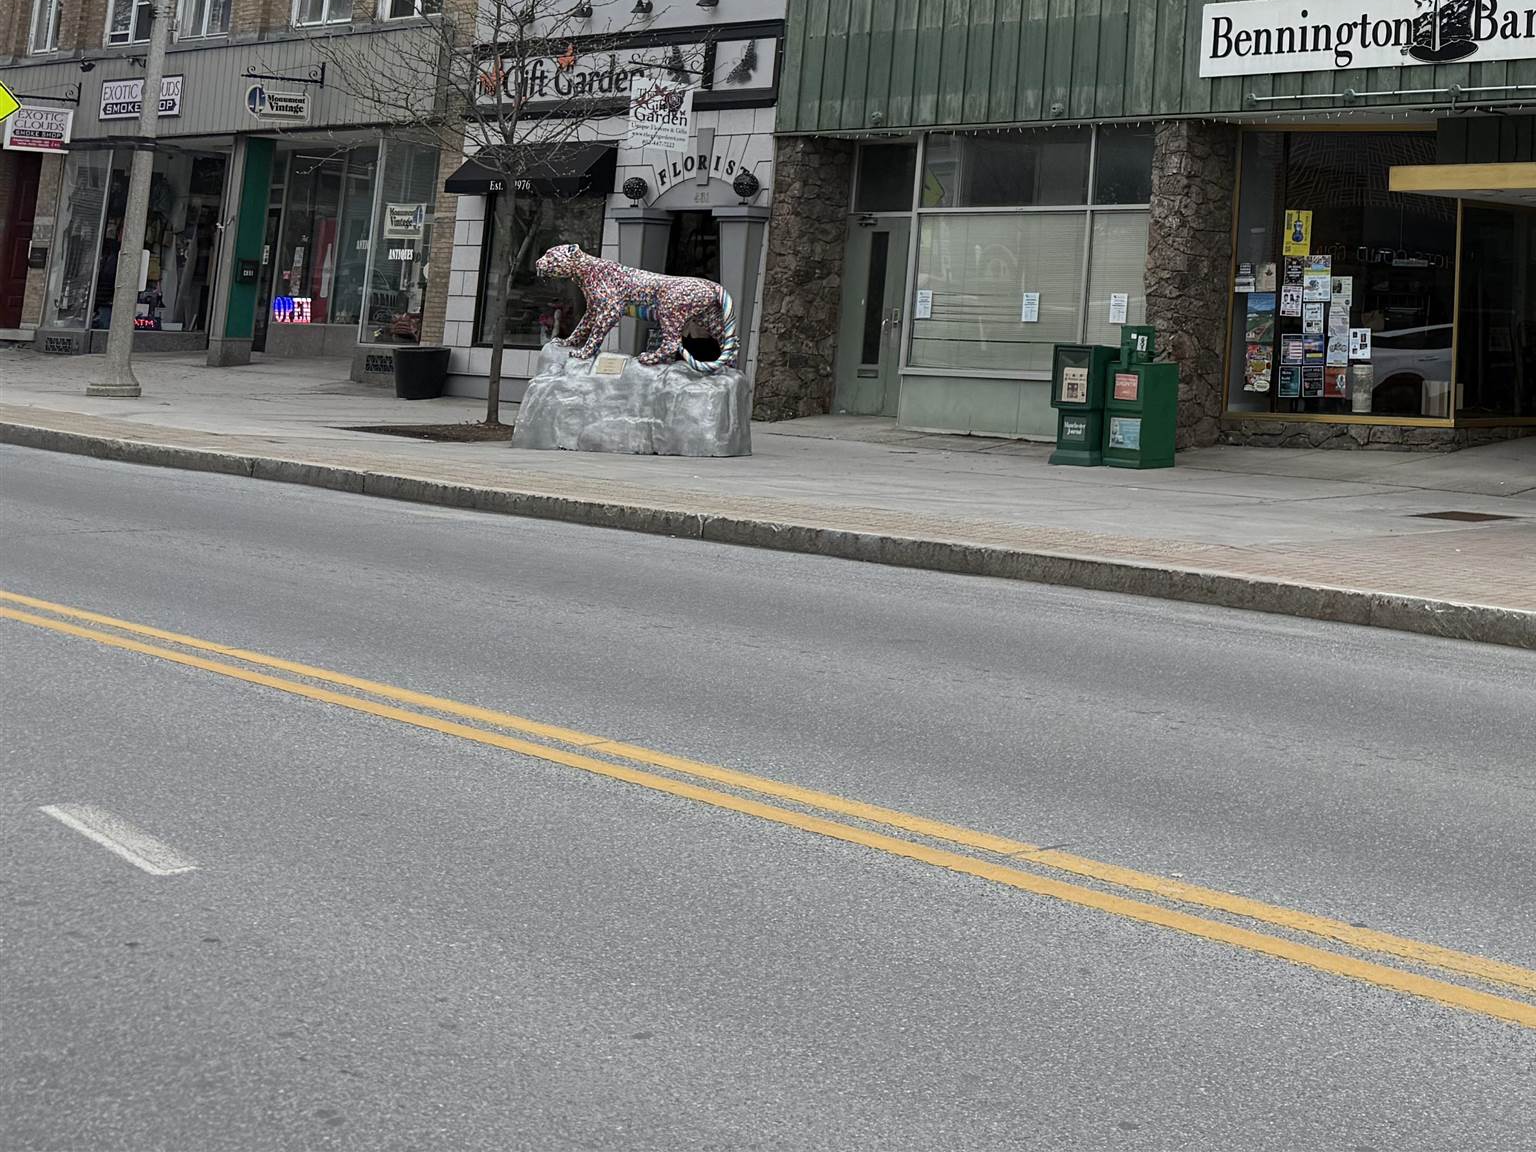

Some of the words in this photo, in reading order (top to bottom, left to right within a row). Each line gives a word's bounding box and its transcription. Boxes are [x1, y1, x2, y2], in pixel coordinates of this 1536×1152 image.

[1209, 9, 1414, 68] Bennington
[102, 83, 139, 102] EXOTIC
[267, 94, 306, 104] Monument
[105, 103, 141, 114] SMOKE
[268, 101, 304, 115] Vintage
[17, 109, 64, 123] EXOTIC
[634, 105, 688, 127] Garden
[14, 119, 65, 132] CLOUDS
[15, 129, 40, 138] SMOKE
[41, 131, 61, 139] SHOP
[489, 180, 503, 190] Est.
[273, 296, 312, 324] OPEN
[133, 318, 154, 328] ATM
